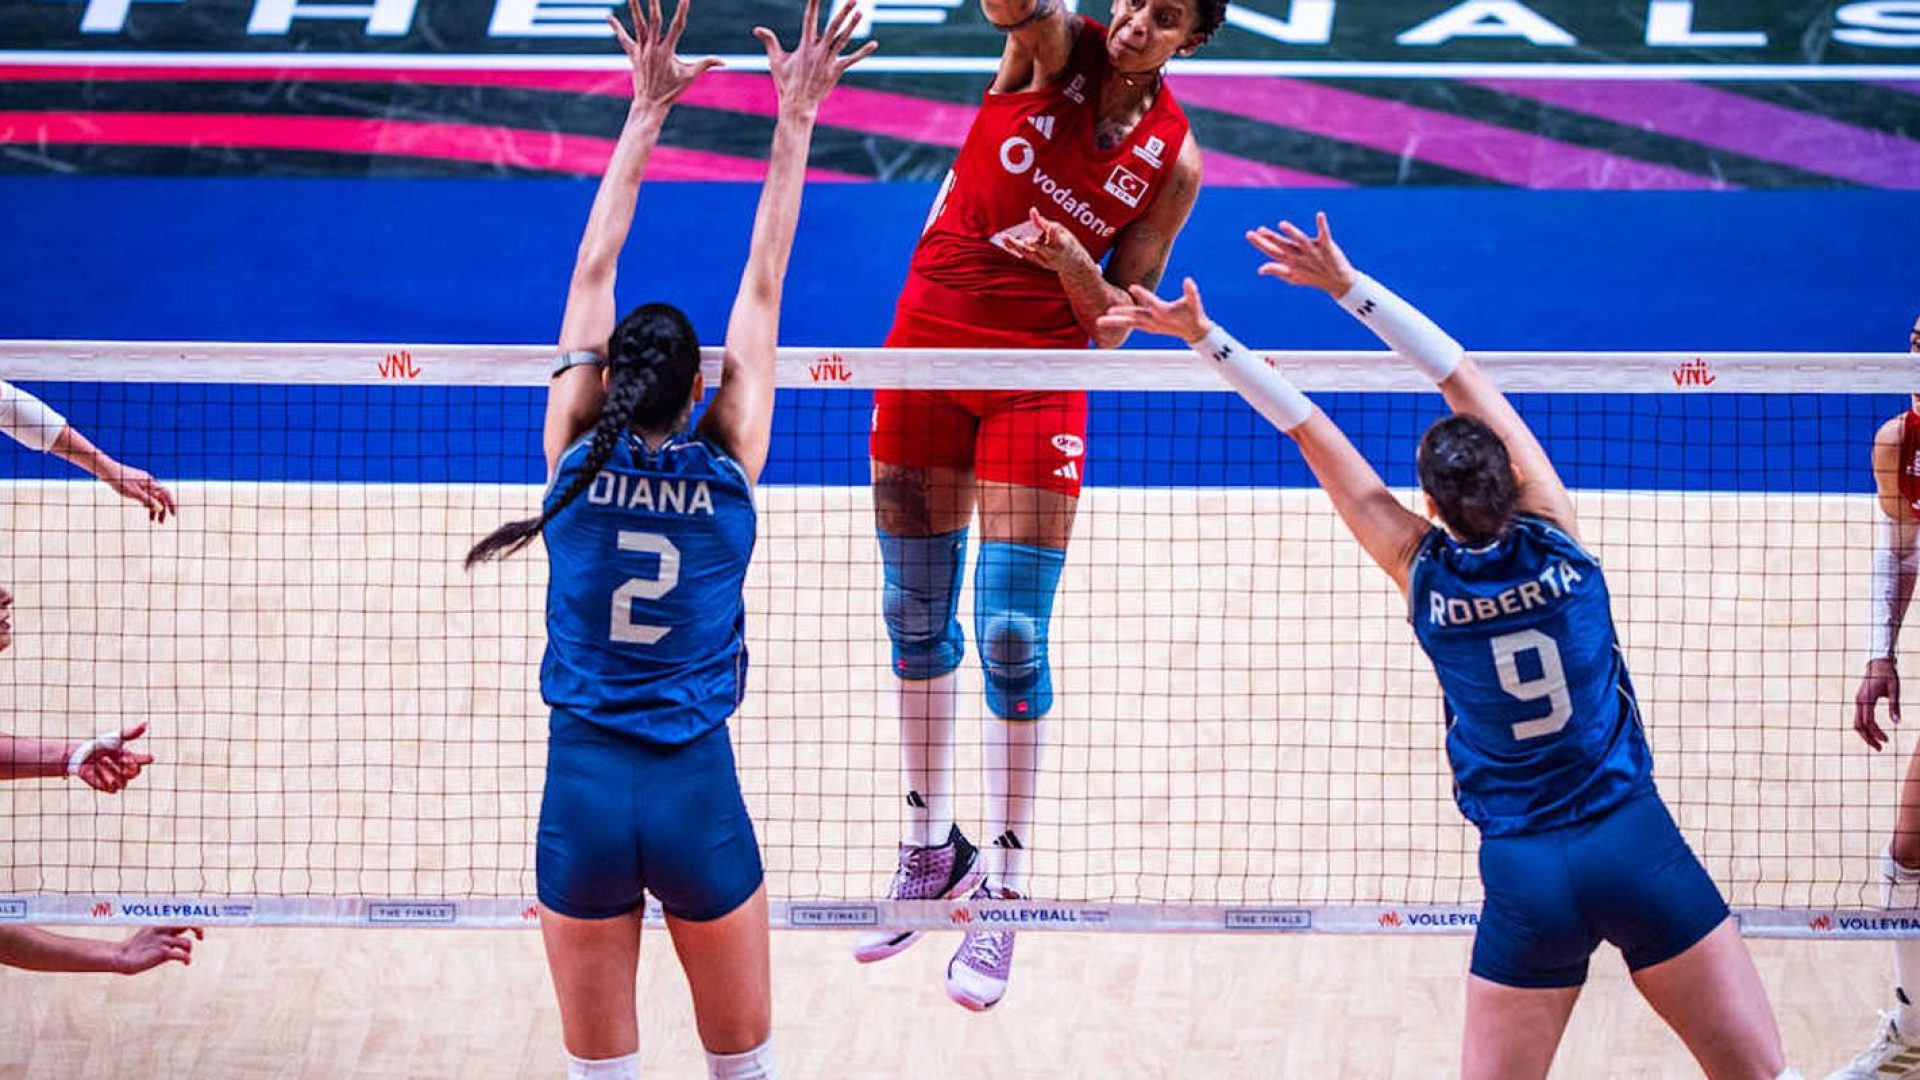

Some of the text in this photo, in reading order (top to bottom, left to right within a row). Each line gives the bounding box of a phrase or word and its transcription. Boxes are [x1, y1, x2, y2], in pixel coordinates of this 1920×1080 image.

[1032, 168, 1116, 237] vodafone
[588, 471, 715, 515] DIANA
[609, 530, 681, 645] 2
[1430, 560, 1582, 626] ROBERTA
[1489, 628, 1573, 740] 9
[122, 905, 219, 916] VOLLEYBALL
[802, 912, 822, 920] THE
[979, 909, 1077, 922] VOLLEYBALL
